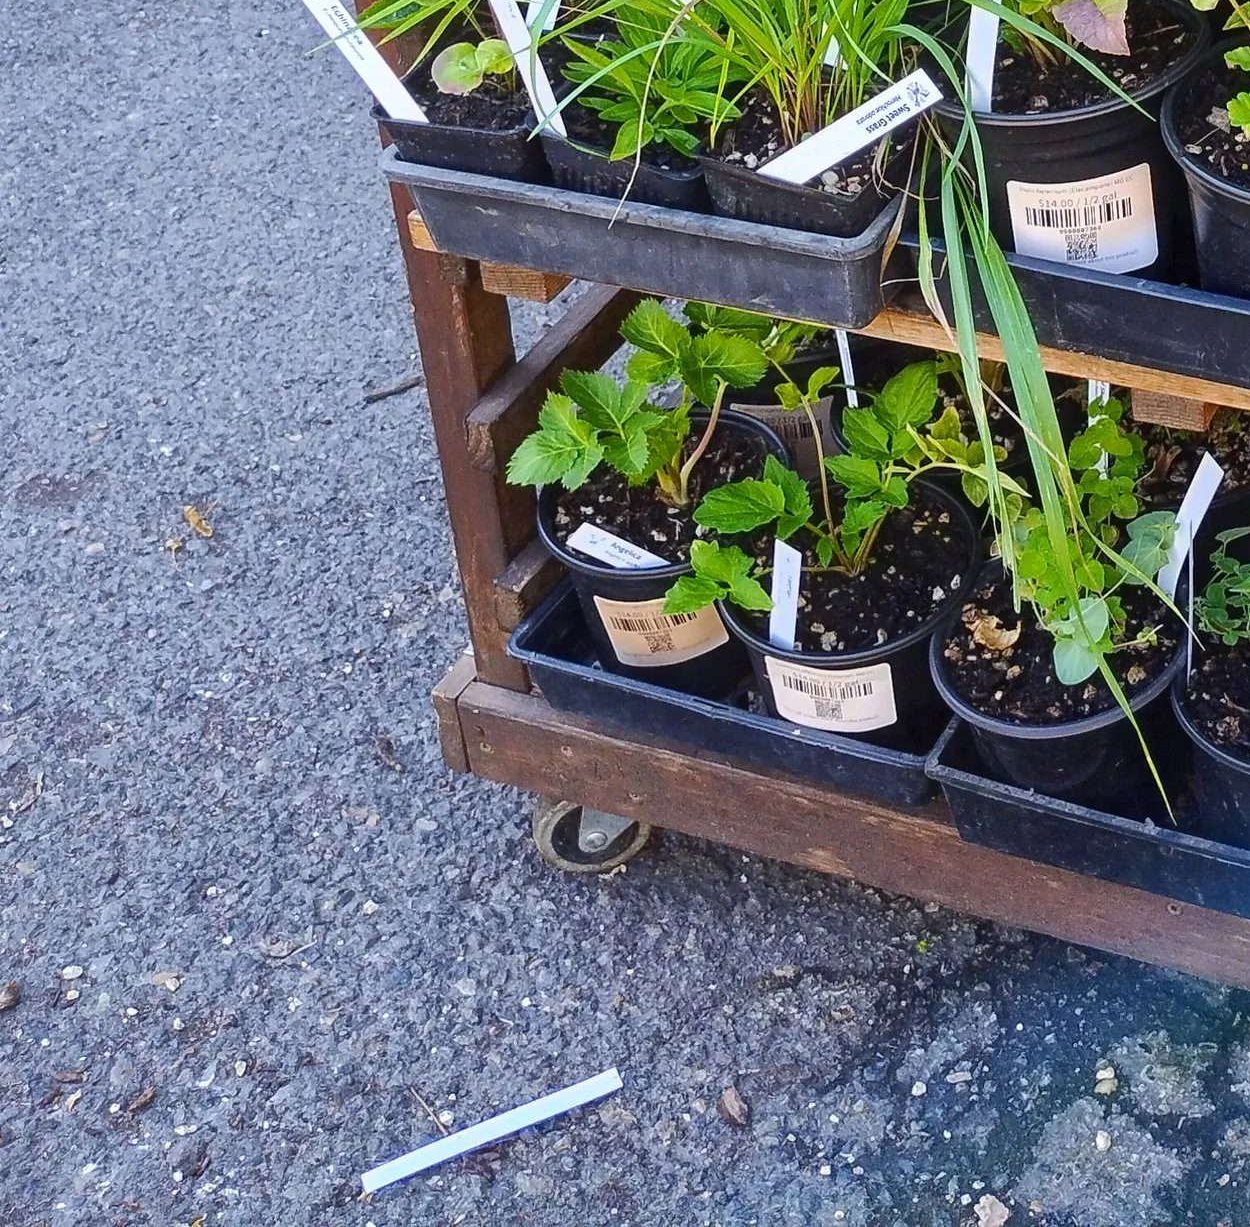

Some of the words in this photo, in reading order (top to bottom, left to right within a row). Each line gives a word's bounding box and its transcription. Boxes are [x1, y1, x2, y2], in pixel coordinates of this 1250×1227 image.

[331, 5, 363, 45] Echinea
[887, 103, 911, 122] Sweet
[866, 118, 888, 133] Grass
[1039, 198, 1073, 208] $14.00
[1084, 195, 1100, 206] 1/2
[1102, 191, 1118, 205] gal
[611, 542, 641, 560] Angelica
